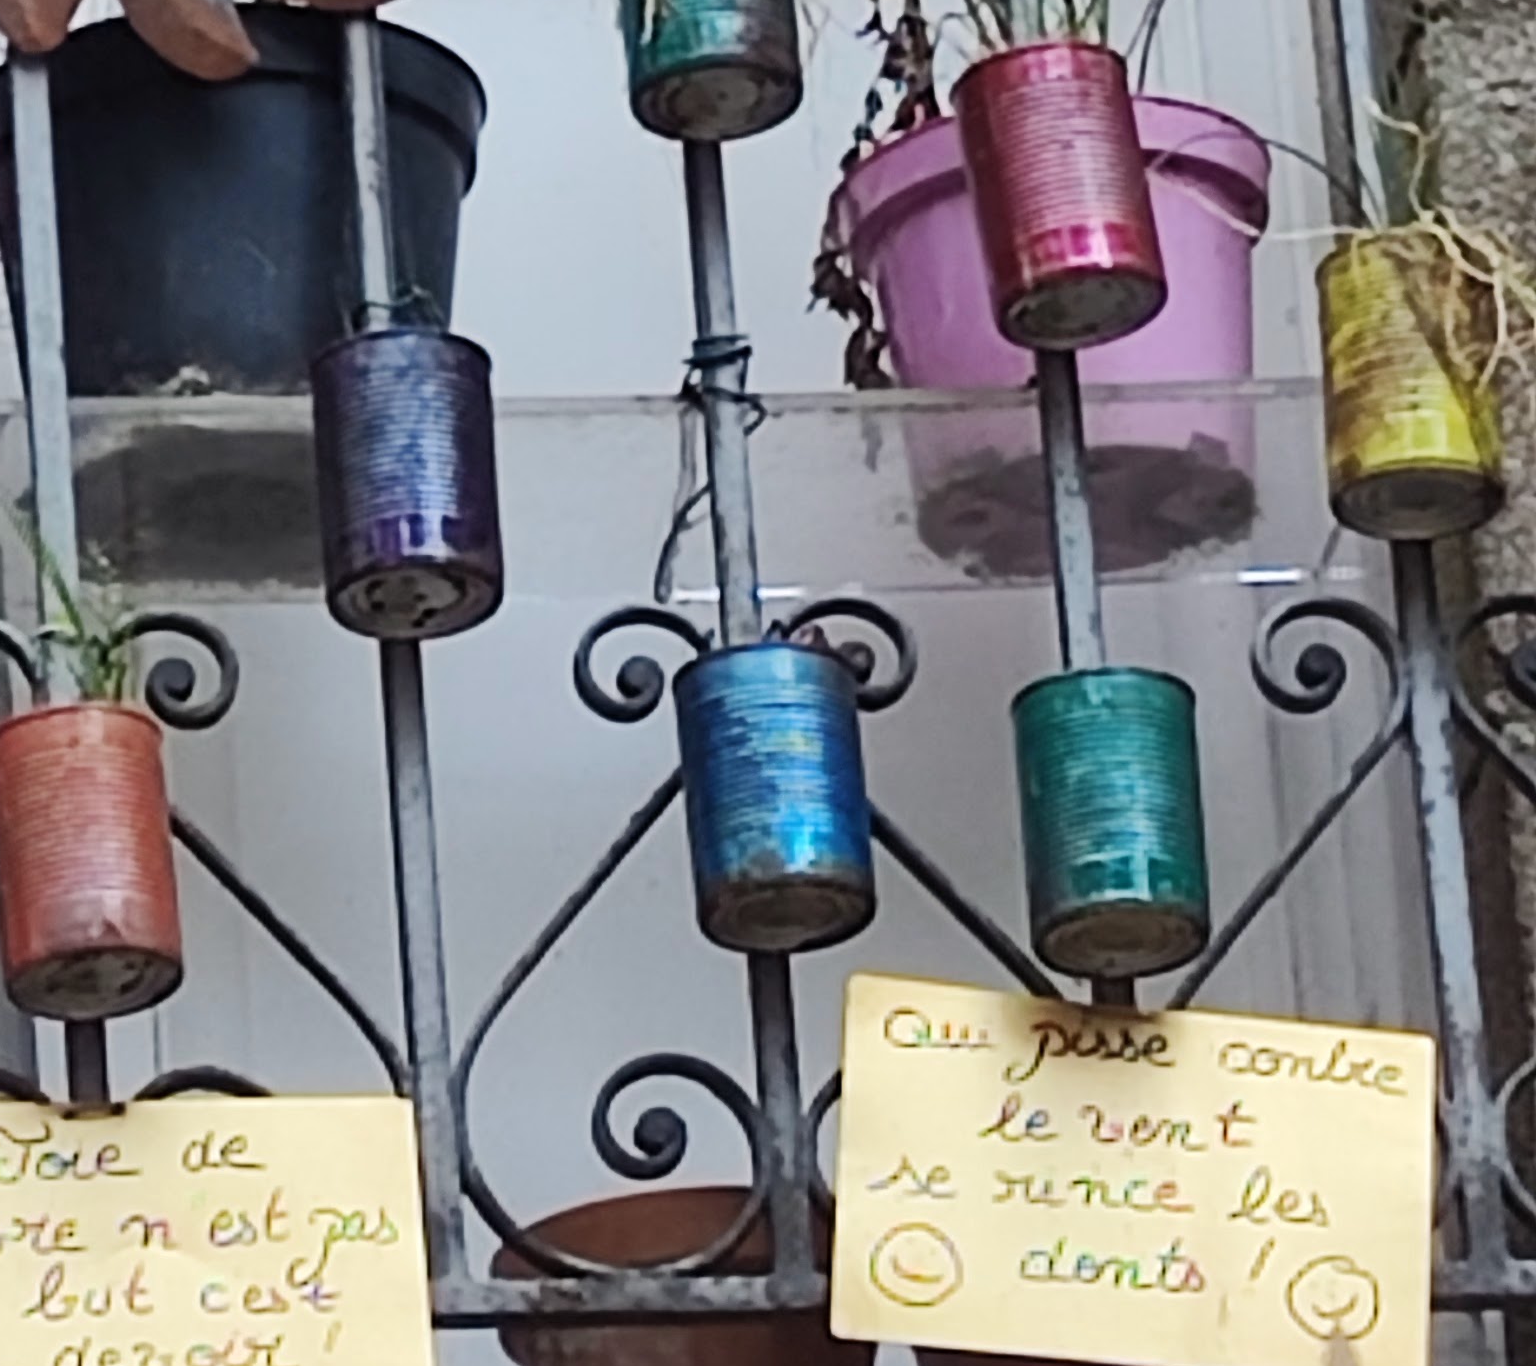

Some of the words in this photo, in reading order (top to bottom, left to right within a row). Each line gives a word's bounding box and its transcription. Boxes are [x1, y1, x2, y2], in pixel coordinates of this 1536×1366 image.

[1002, 1020, 1177, 1084] pisse
[1219, 1039, 1409, 1096] contre
[181, 1132, 267, 1173] de
[977, 1092, 1060, 1142] le
[1078, 1098, 1258, 1153] vent
[867, 1155, 958, 1199] se
[992, 1166, 1195, 1214] rince
[1228, 1166, 1331, 1227] les
[286, 1204, 400, 1288] pas
[21, 1261, 157, 1320] but
